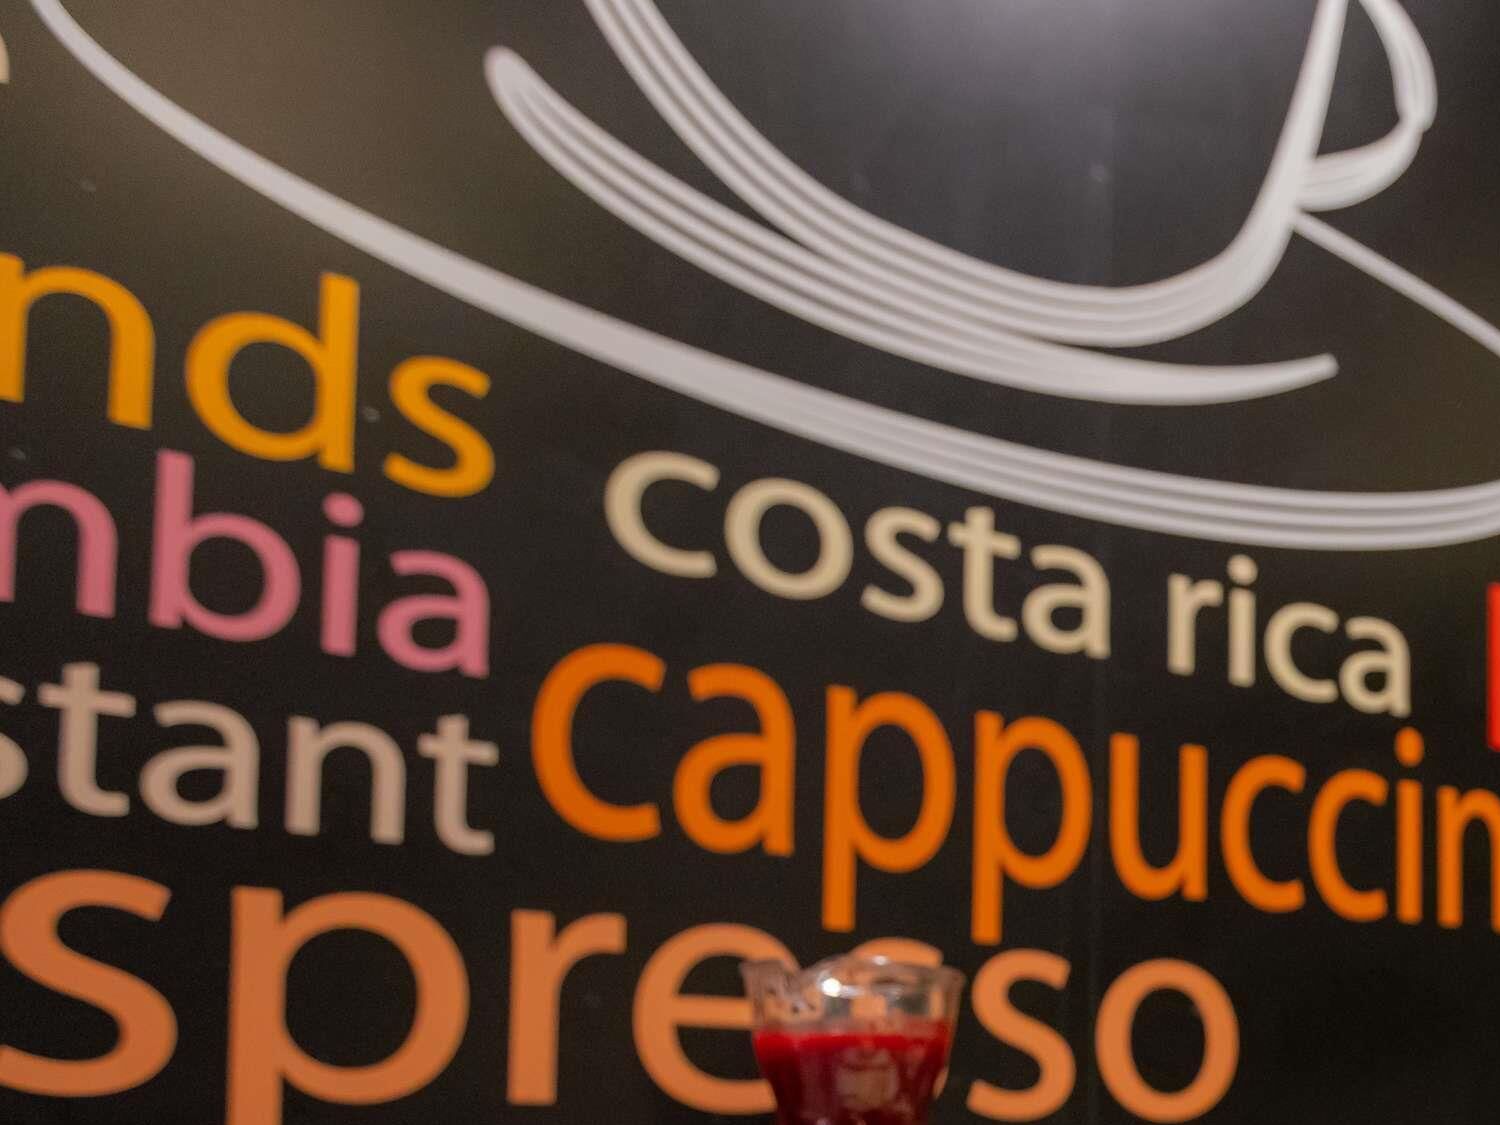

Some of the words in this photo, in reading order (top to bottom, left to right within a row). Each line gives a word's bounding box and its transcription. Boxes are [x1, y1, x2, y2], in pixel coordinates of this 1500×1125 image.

[0, 253, 495, 498] nds
[604, 450, 1111, 660] costa
[1166, 555, 1414, 717] rica
